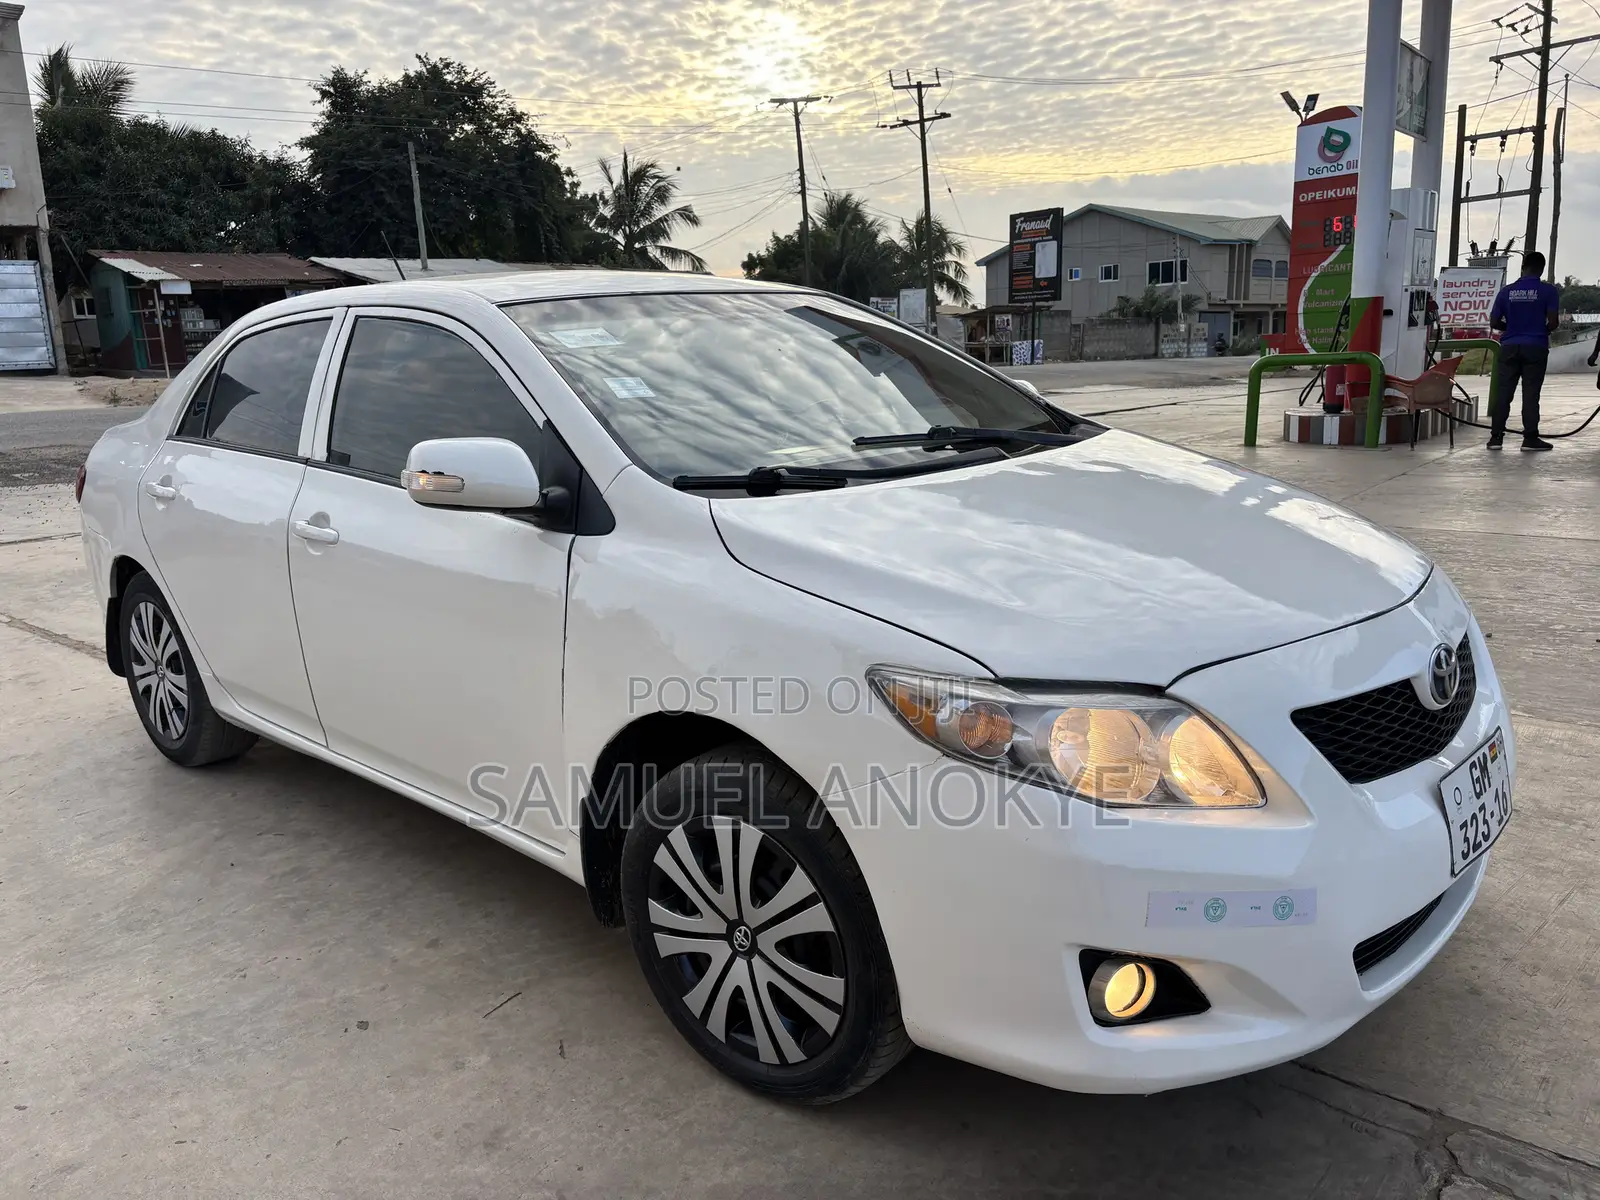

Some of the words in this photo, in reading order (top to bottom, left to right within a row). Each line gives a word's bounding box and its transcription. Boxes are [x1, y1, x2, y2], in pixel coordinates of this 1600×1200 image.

[1308, 162, 1344, 176] benab
[1346, 159, 1358, 170] Oil
[1299, 186, 1358, 202] OPEIKUM
[1442, 278, 1497, 289] laundry
[1442, 289, 1495, 299] service
[1443, 300, 1491, 312] NOW
[1439, 312, 1489, 324] OPEN
[1266, 347, 1279, 355] IN
[1469, 751, 1492, 800] GM
[1459, 780, 1508, 860] 323-16
